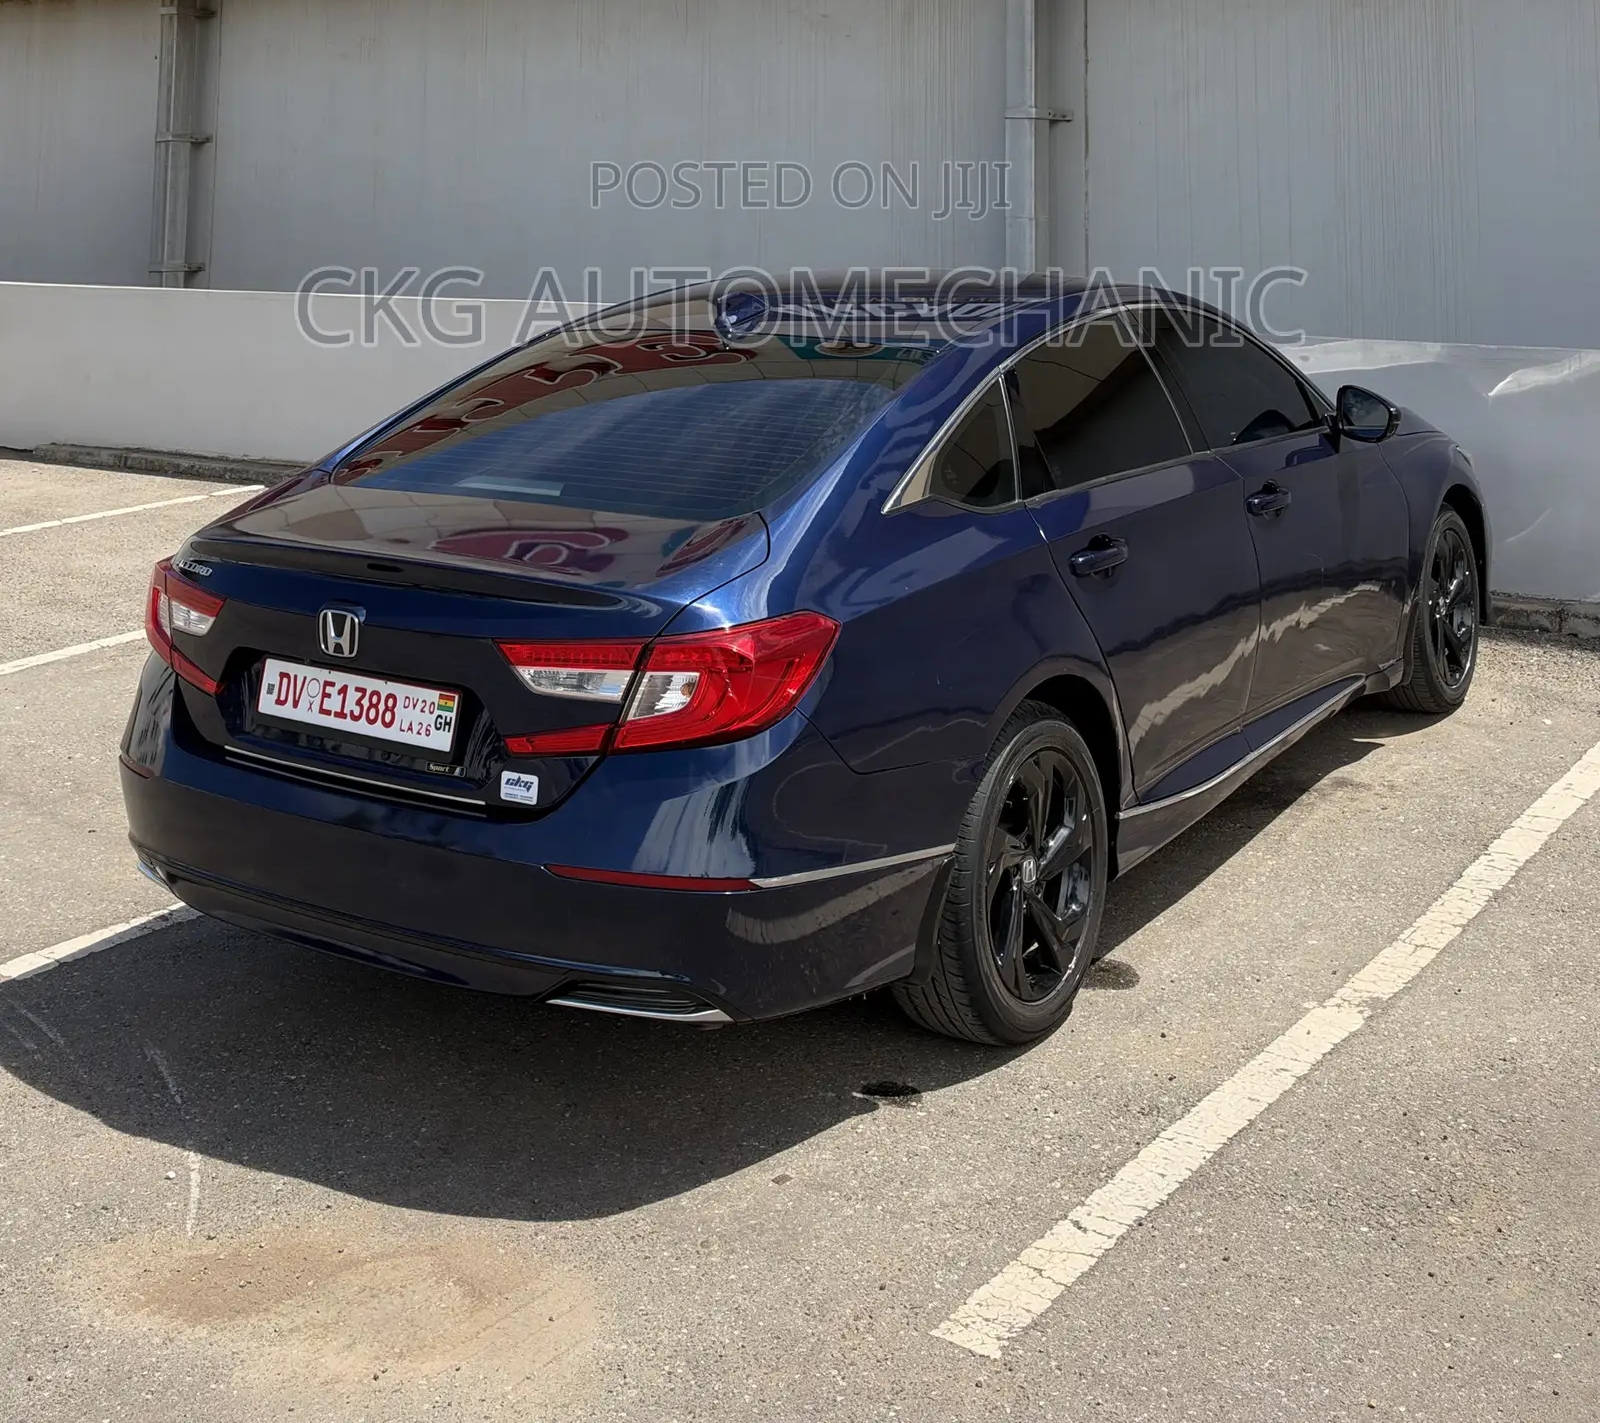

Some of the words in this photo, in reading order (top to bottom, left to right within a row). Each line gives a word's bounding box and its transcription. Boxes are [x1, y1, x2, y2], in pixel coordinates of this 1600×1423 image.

[274, 671, 307, 709] DV
[318, 679, 398, 729] E1388
[434, 713, 452, 733] GH
